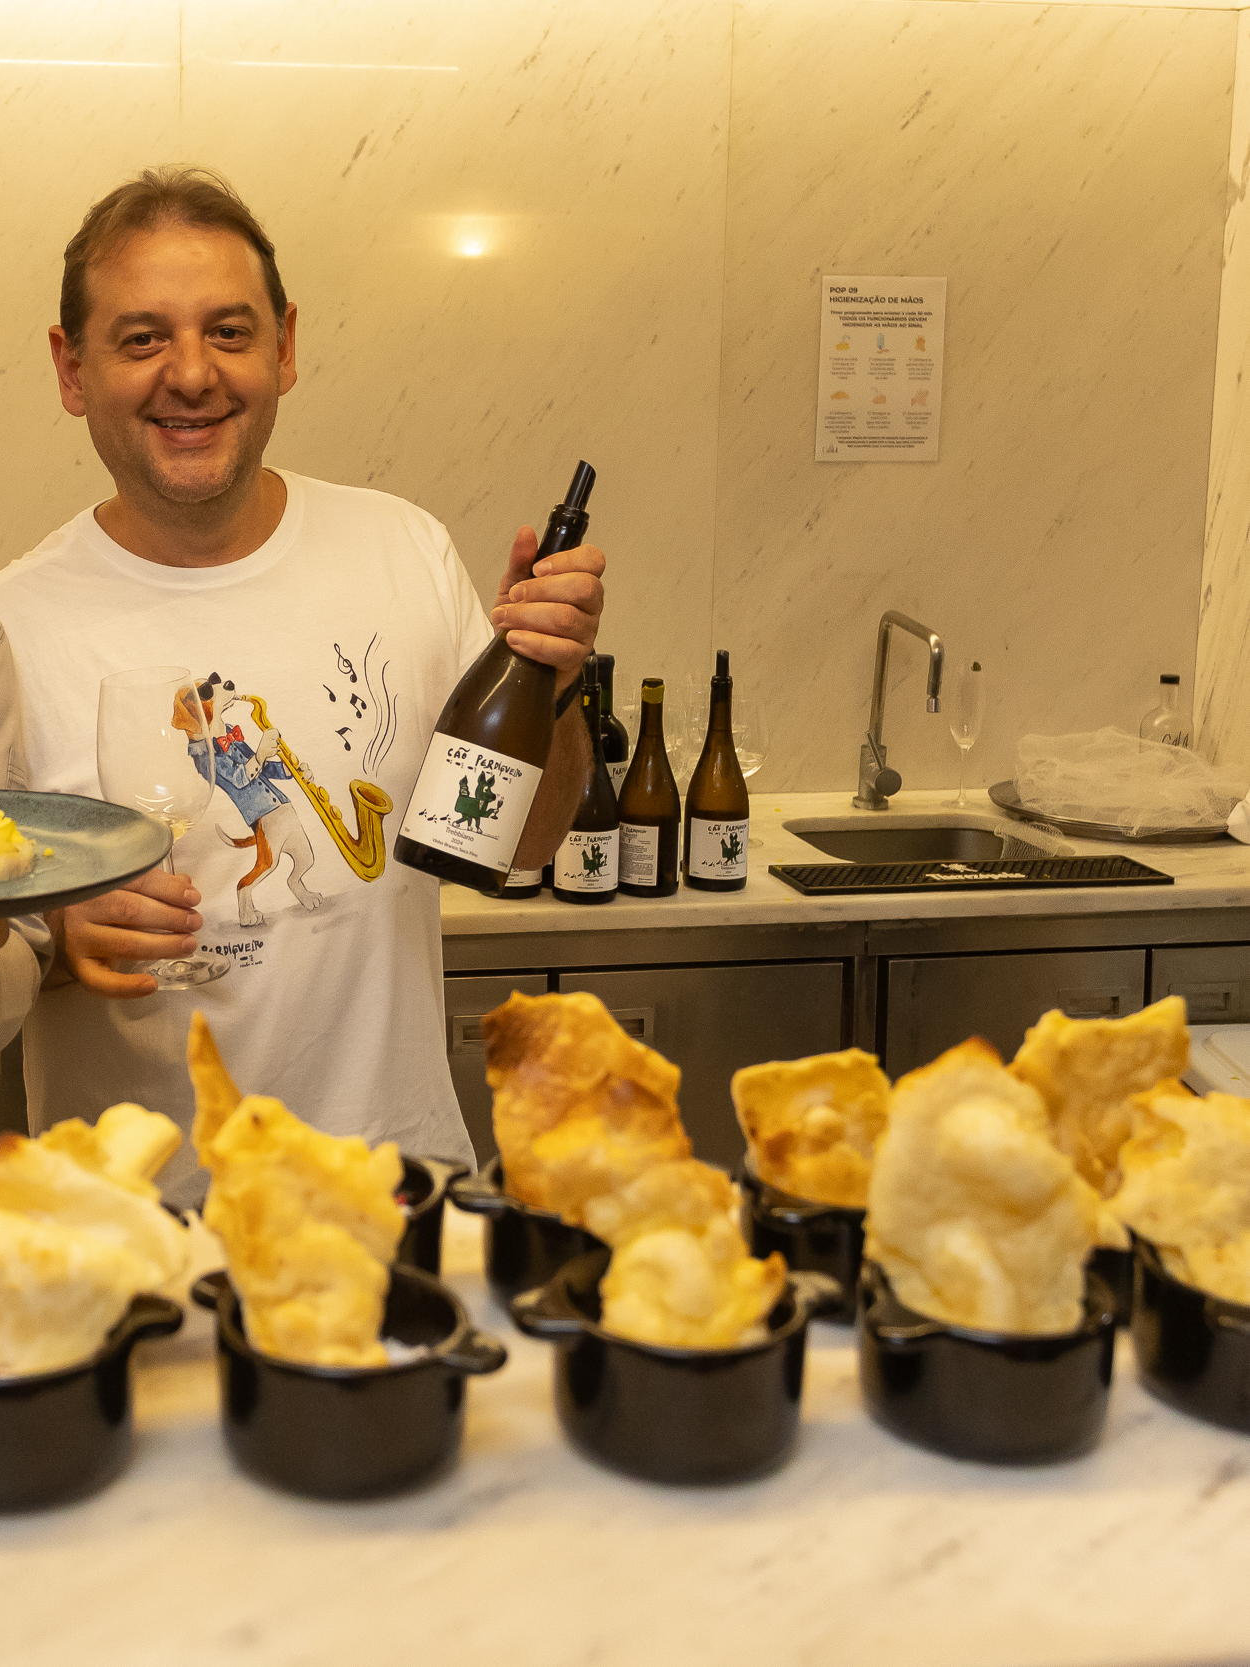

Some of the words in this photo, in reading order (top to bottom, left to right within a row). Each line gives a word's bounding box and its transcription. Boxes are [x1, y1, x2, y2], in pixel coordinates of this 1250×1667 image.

[830, 295, 886, 305] HIGIENIZAÇÃO
[901, 296, 924, 304] MÃOS
[447, 747, 471, 760] CÃO
[445, 826, 475, 842] Trebbiano
